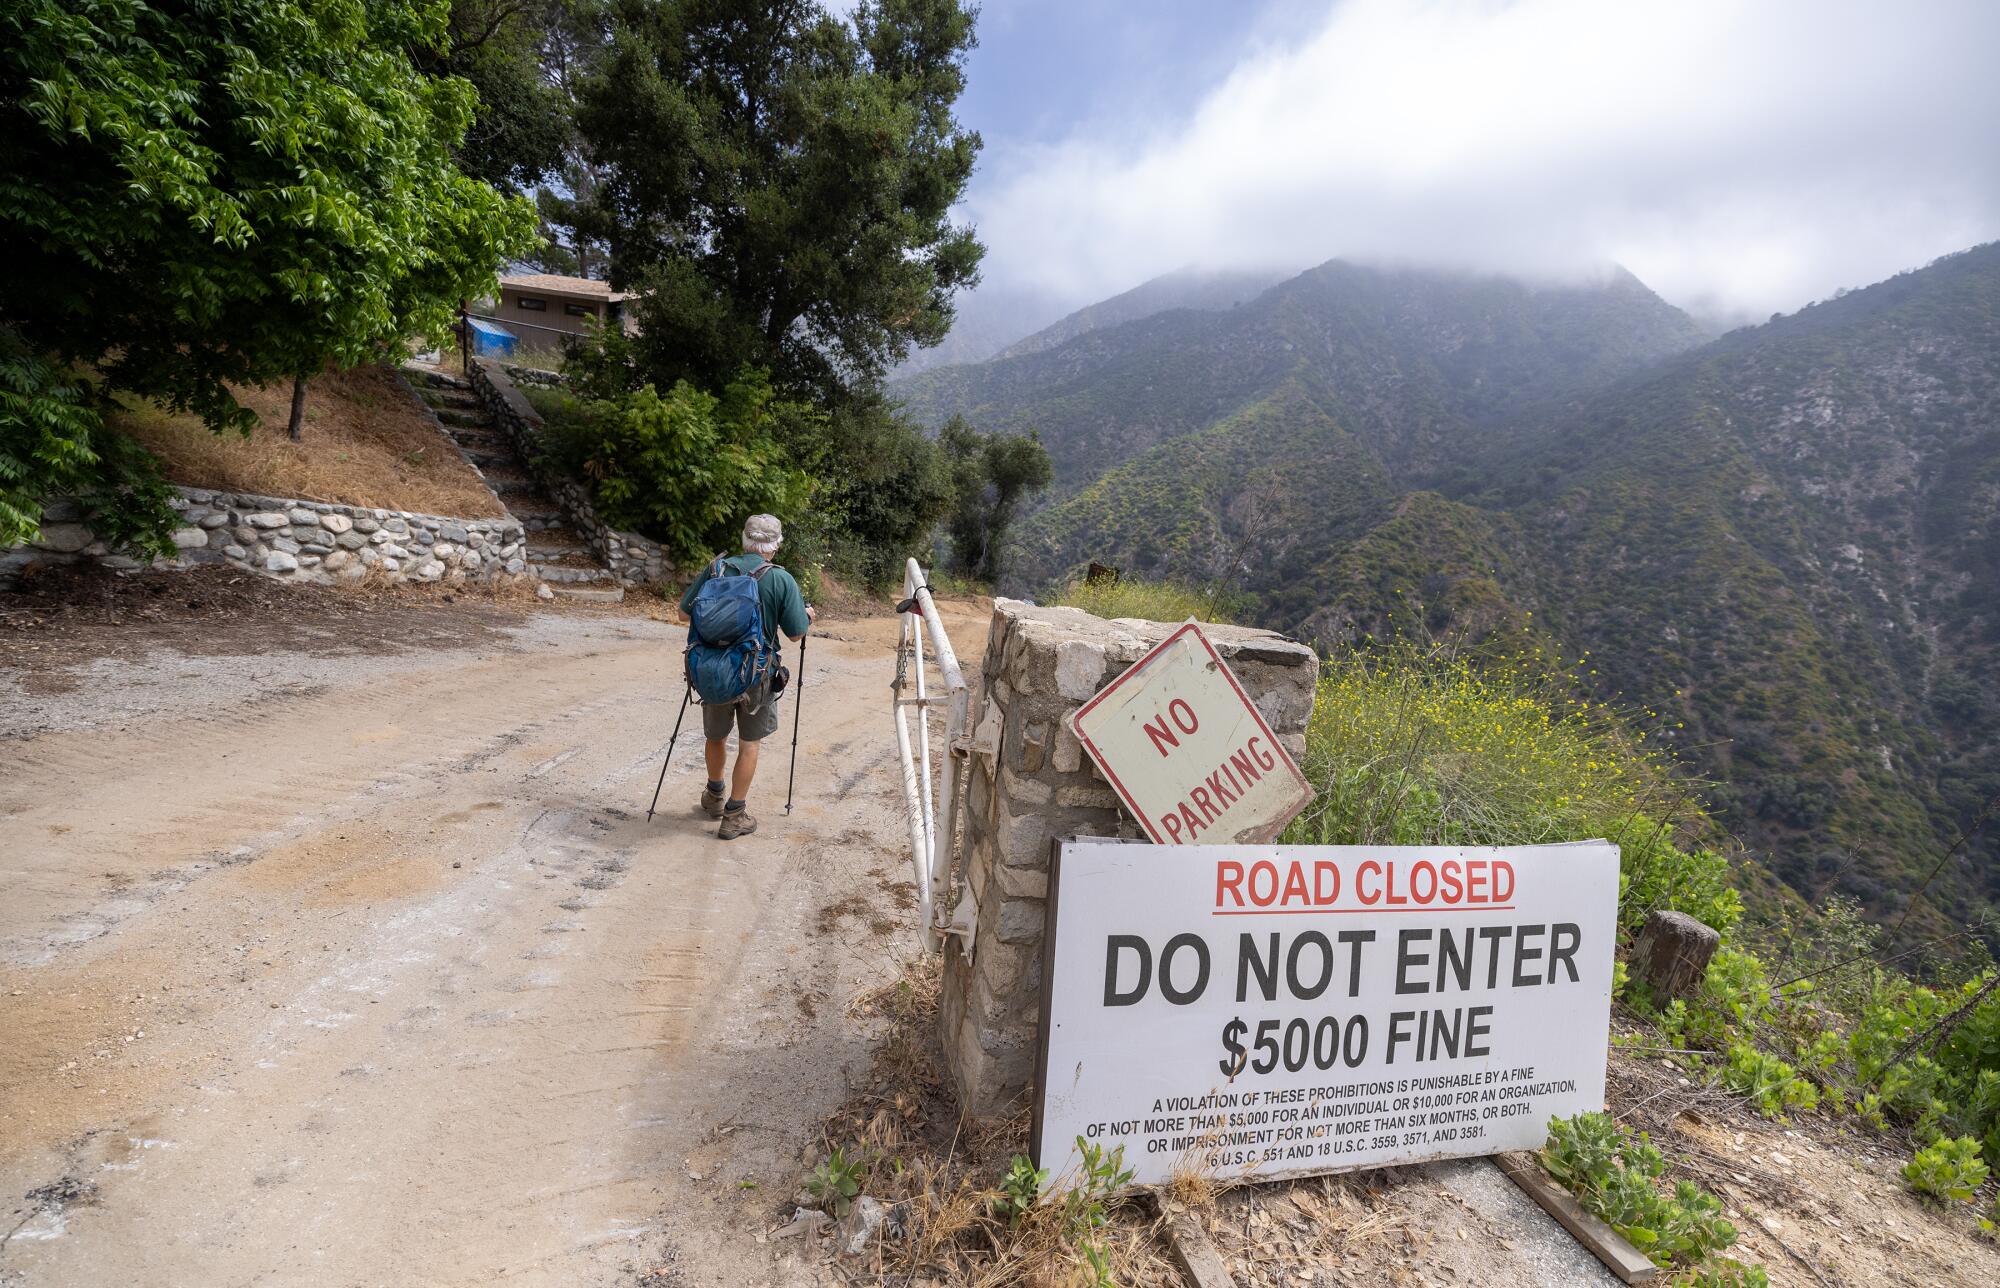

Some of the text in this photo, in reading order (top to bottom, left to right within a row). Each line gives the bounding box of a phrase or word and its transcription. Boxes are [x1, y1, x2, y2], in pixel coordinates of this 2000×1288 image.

[1143, 698, 1199, 758] NO
[1160, 736, 1275, 845] PARKING
[1215, 859, 1516, 908] ROAD CLOSED
[1103, 922, 1581, 1007] DO NOT ENTER
[1219, 1005, 1494, 1083] $5000 FINE
[1086, 1123, 1106, 1138] OF
[1110, 1120, 1140, 1136] NOT
[1144, 1117, 1184, 1134] MORE
[1229, 1111, 1269, 1128] $5,000
[1272, 1108, 1299, 1123] FOR
[1301, 1106, 1319, 1121] AN
[1322, 1100, 1389, 1119] INDIVIDUAL
[1392, 1097, 1410, 1111] OR
[1412, 1093, 1453, 1110] $10,000
[1455, 1090, 1478, 1105] FOR
[1480, 1089, 1496, 1102] AN
[1498, 1079, 1577, 1100] ORGANIZATION,
[1152, 1067, 1534, 1113] A VIOLATION OF THESE PROHIBITIONS IS PUNISHABLE BY A FINE
[1147, 1102, 1532, 1153] OR IMPRISONMENT FOR NOT MORE THAN SIX MONTHS, OR BOTH.
[1222, 1149, 1259, 1166] U.S.C.
[1263, 1147, 1283, 1162] 551
[1286, 1144, 1314, 1160] AND
[1317, 1142, 1331, 1156] 18
[1334, 1138, 1368, 1154] U.S.C.
[1371, 1134, 1399, 1150] 3559,
[1402, 1131, 1430, 1146] 3571,
[1432, 1128, 1457, 1143] AND
[1460, 1125, 1487, 1140] 3581.
